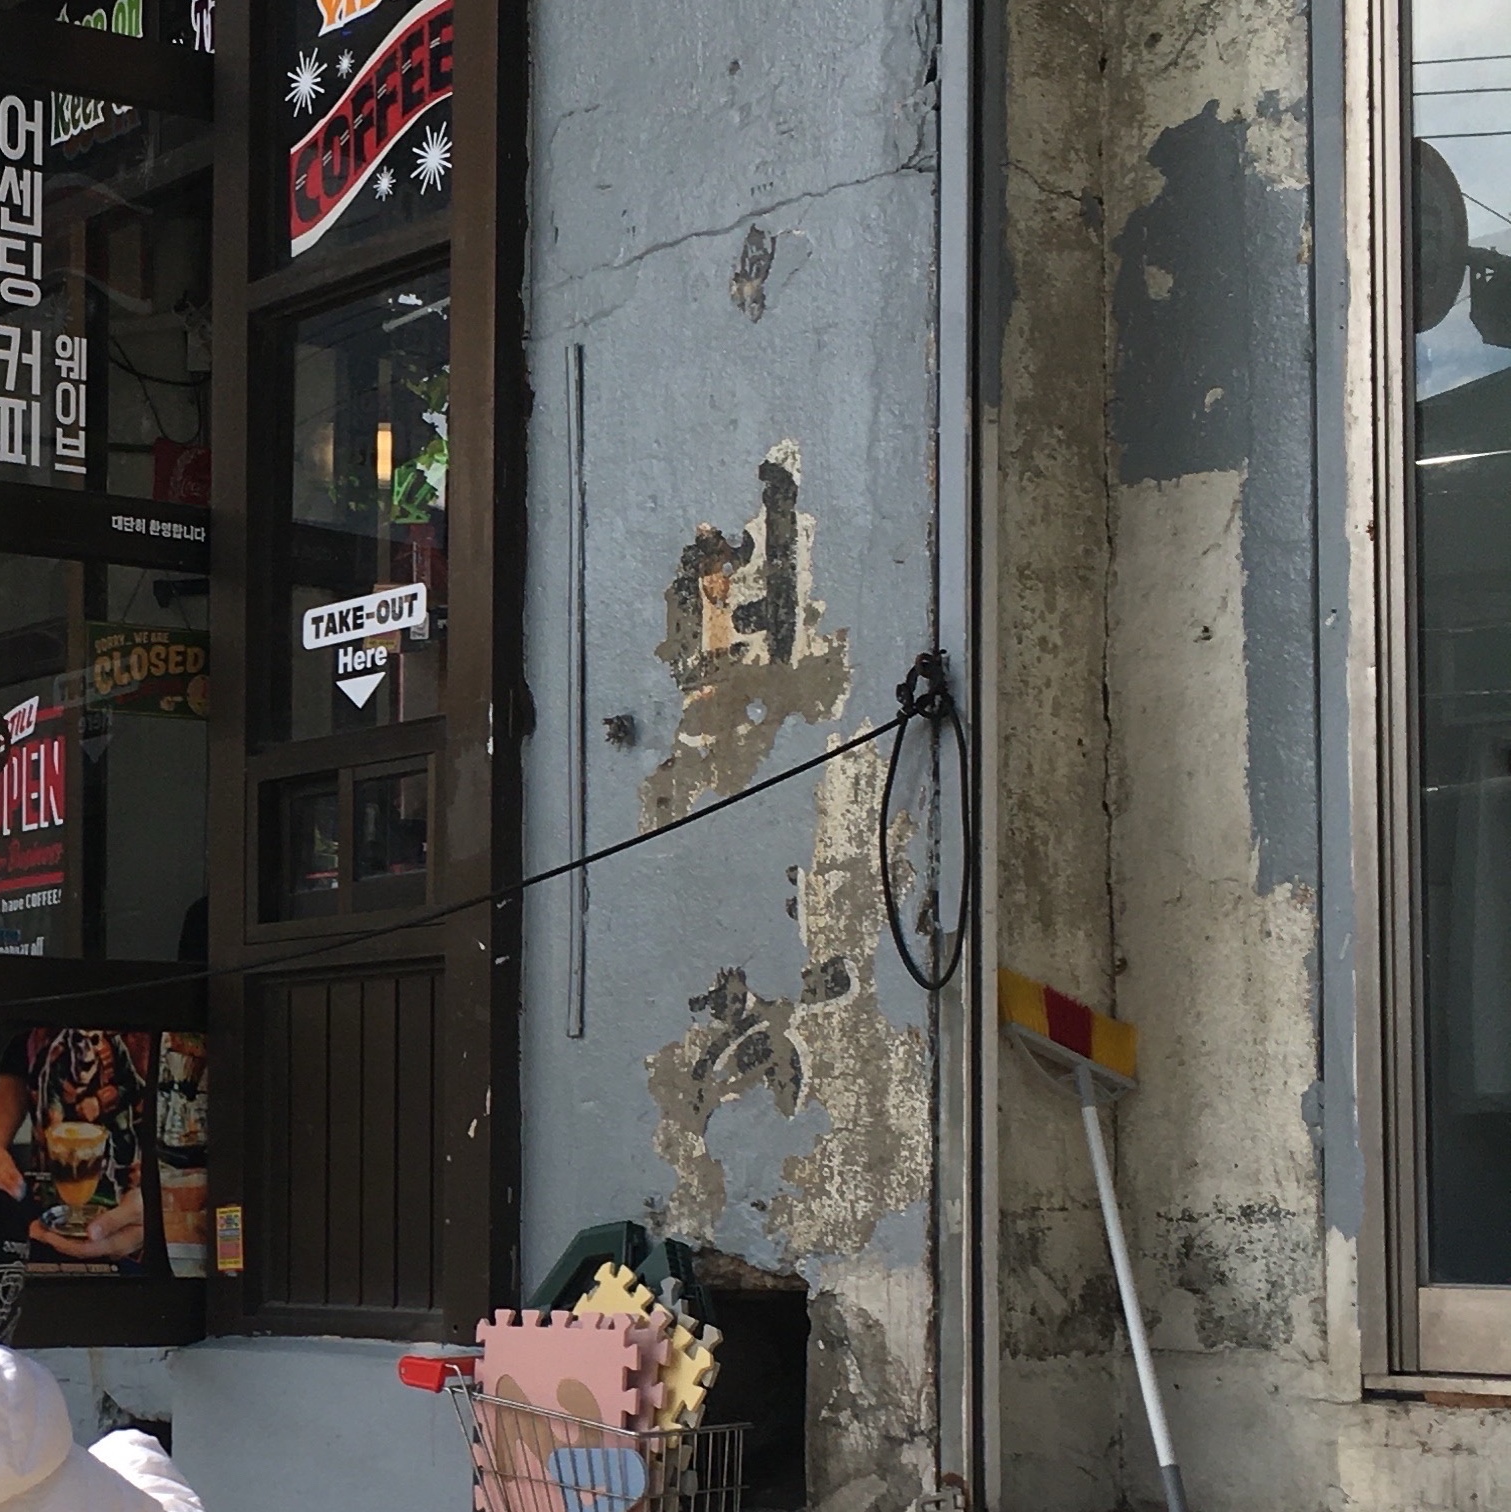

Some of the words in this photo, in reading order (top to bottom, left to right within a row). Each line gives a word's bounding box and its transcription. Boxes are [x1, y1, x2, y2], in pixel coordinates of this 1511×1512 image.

[294, 8, 454, 223] COFFEE
[54, 334, 87, 474] 웨이브
[111, 515, 146, 534] 대단히
[149, 519, 206, 542] 환영합니다
[311, 592, 418, 640] TAKE-OUT
[93, 644, 206, 695] CLOSED
[338, 646, 388, 675] Here
[1, 896, 25, 913] have
[25, 889, 62, 909] COFFEE!
